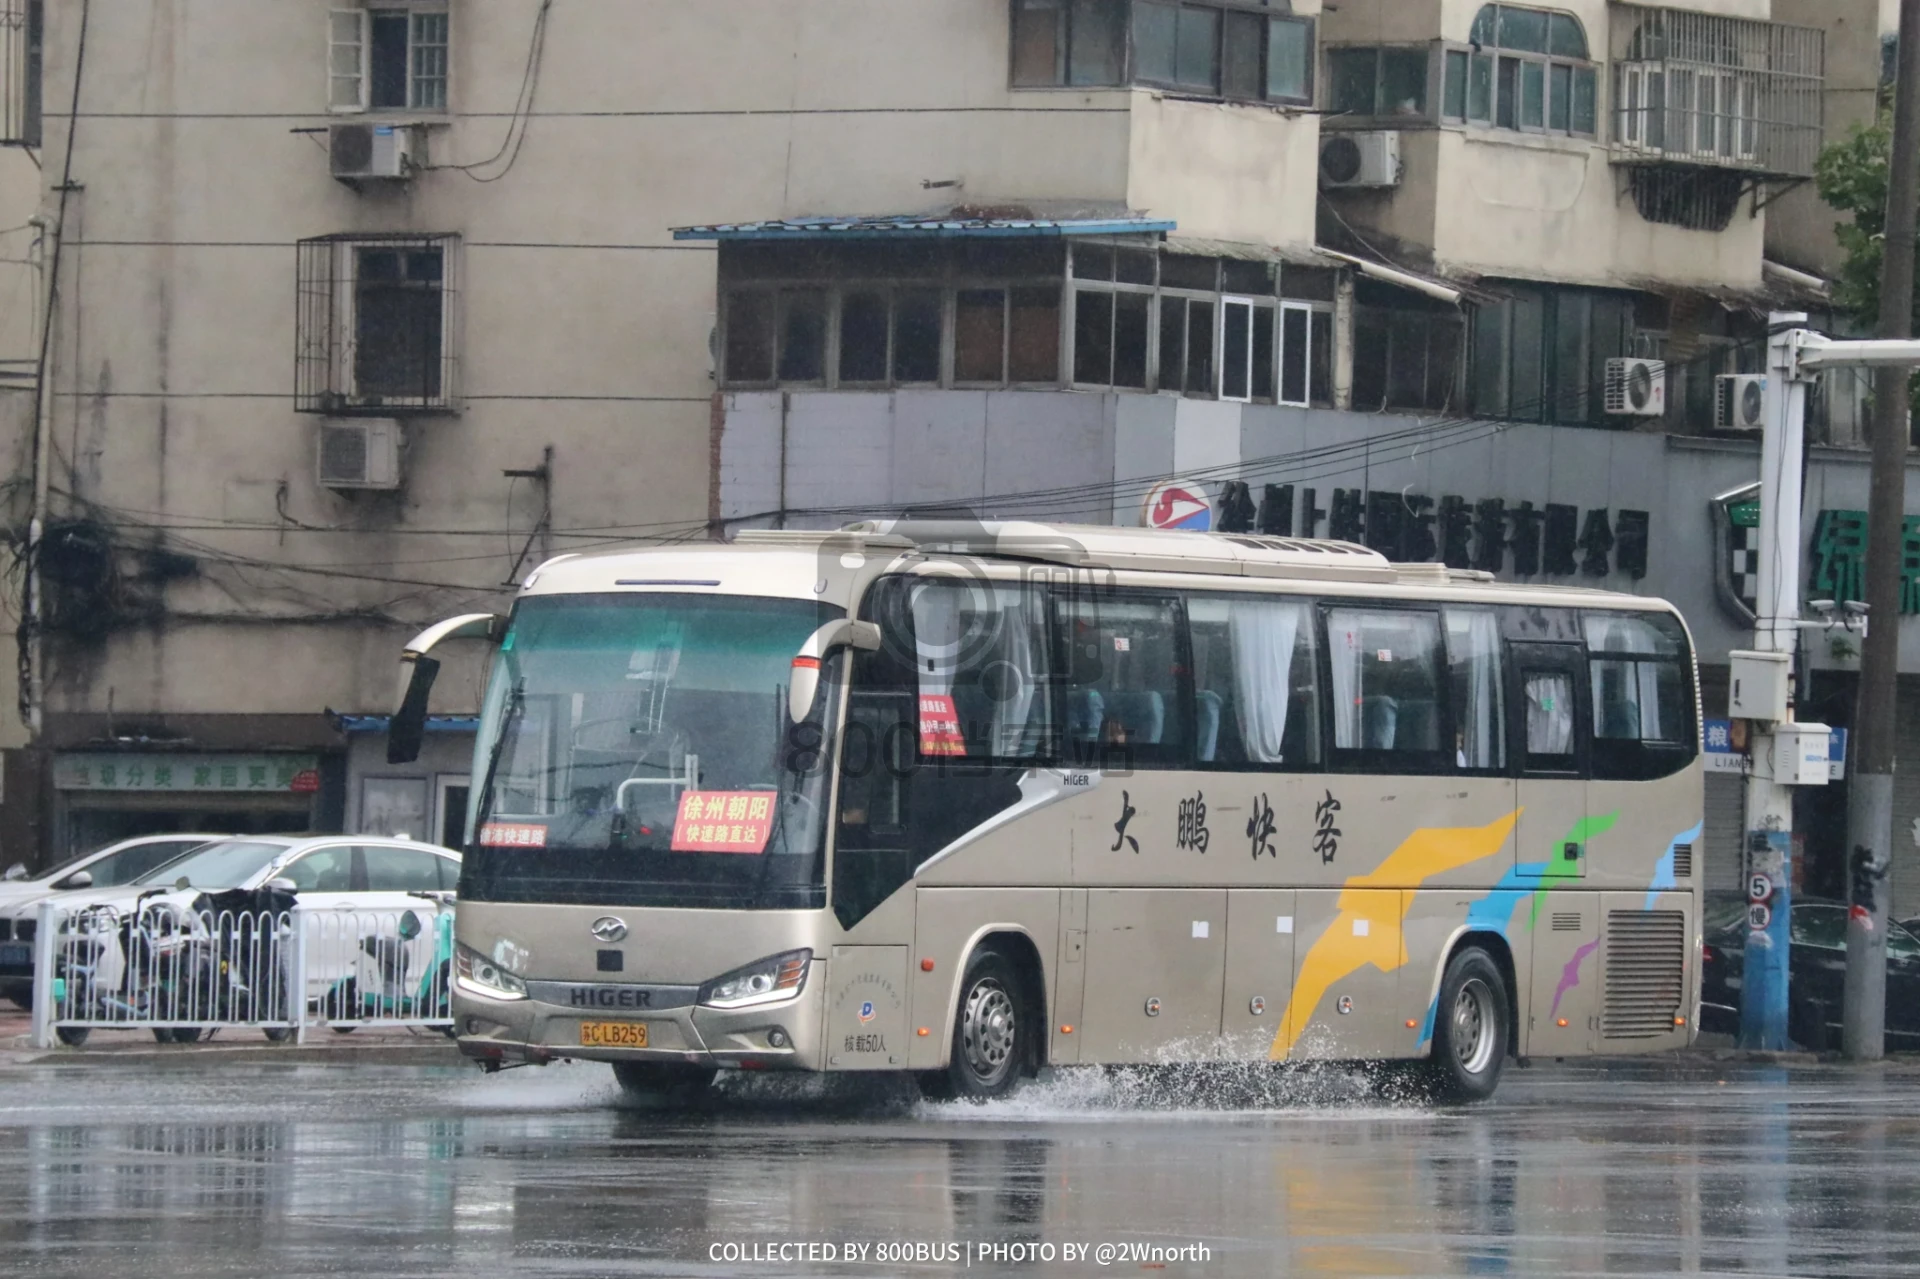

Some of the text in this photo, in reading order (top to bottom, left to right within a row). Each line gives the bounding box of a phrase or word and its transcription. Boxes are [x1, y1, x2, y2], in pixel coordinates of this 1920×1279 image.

[1063, 774, 1089, 786] HIGER
[684, 795, 769, 820] 徐州朝阳
[1111, 789, 1343, 865] 大鹏快客
[1753, 878, 1765, 897] 5
[571, 988, 651, 1007] HIGER
[844, 1034, 887, 1053] 核载50人
